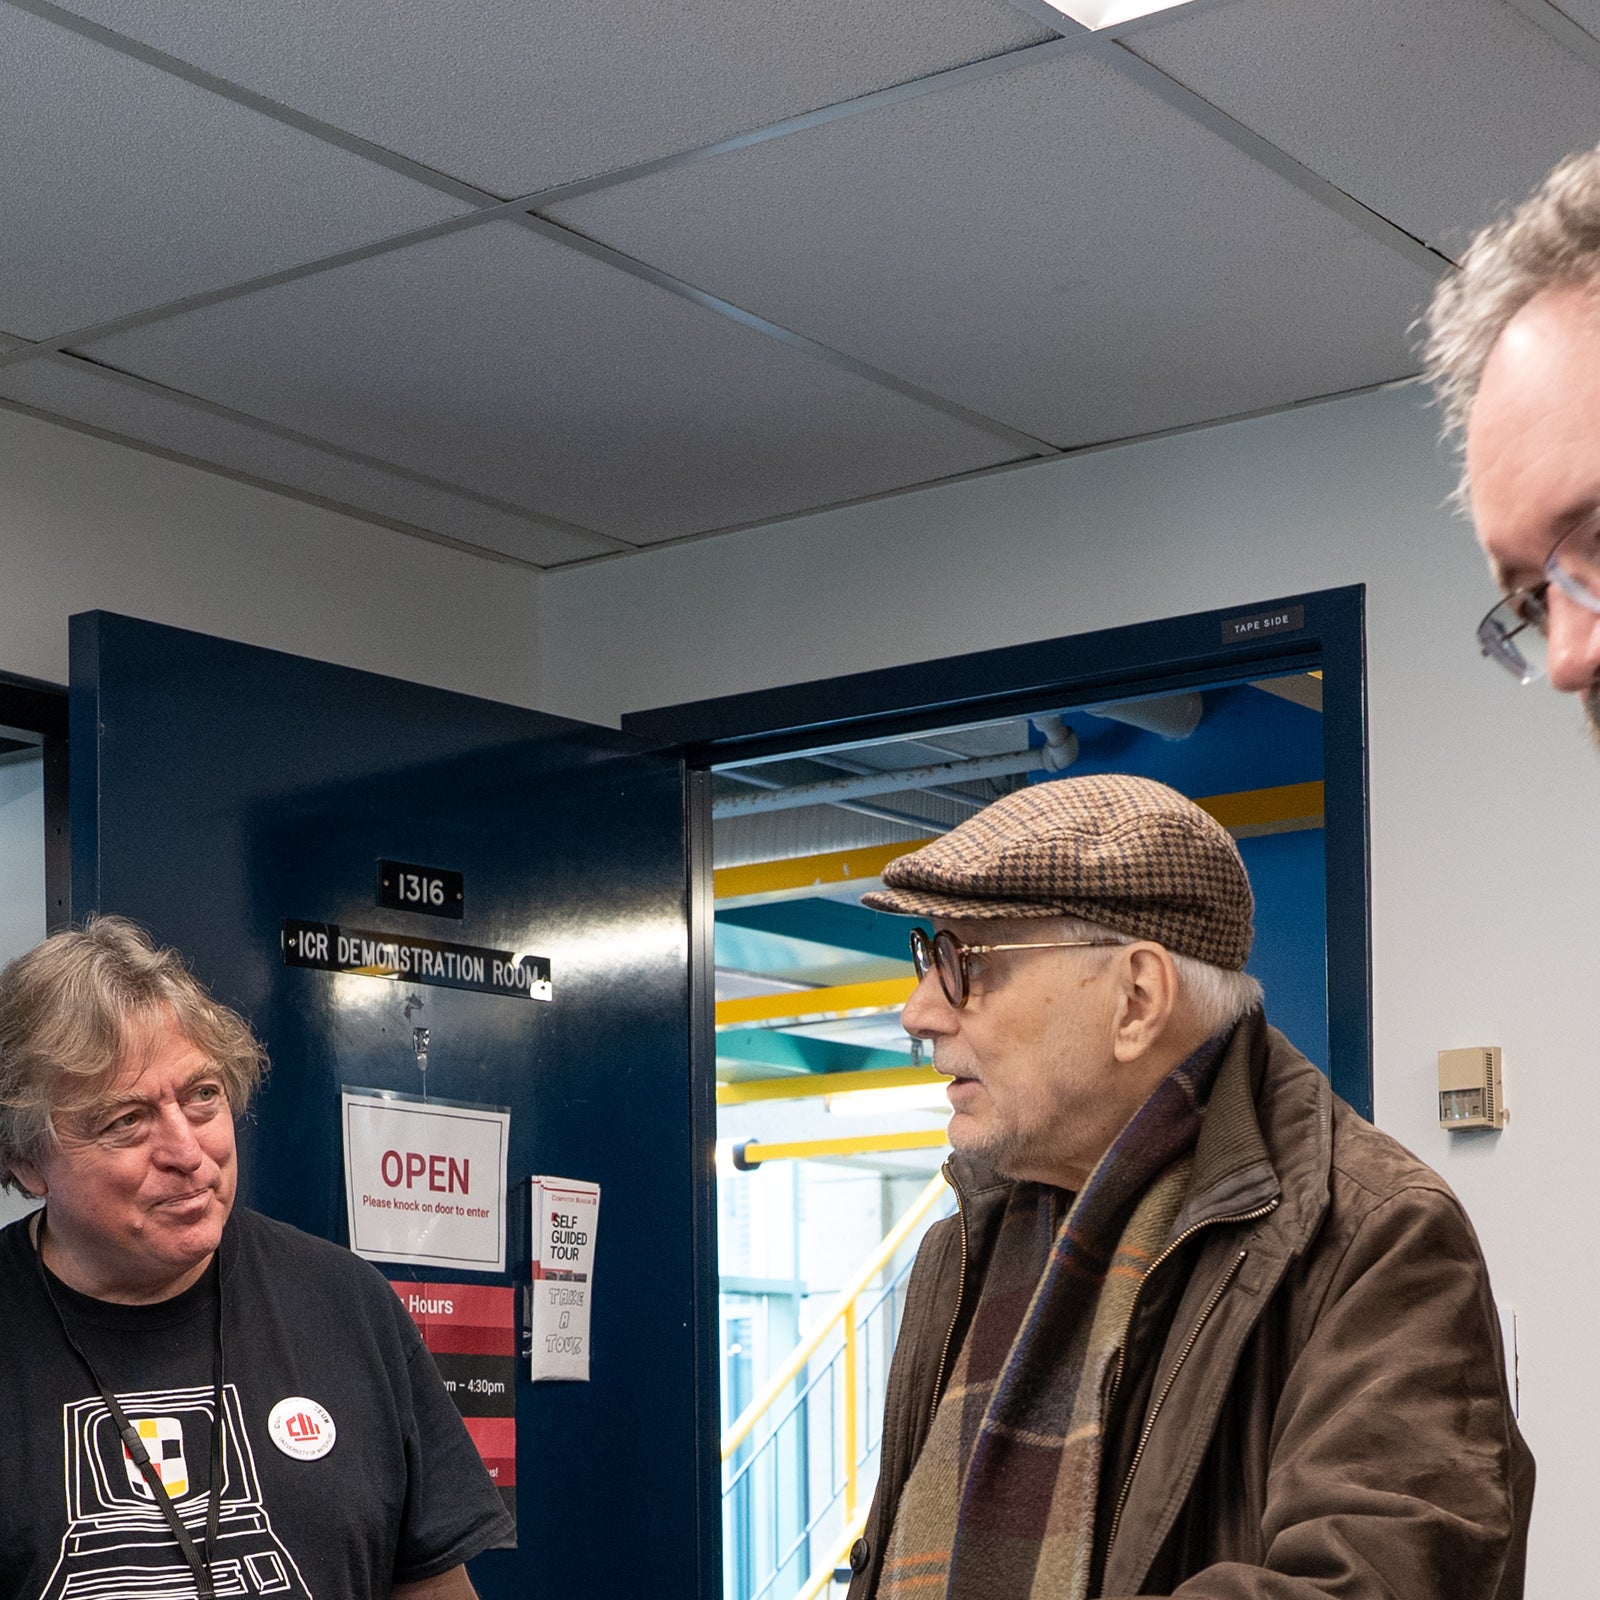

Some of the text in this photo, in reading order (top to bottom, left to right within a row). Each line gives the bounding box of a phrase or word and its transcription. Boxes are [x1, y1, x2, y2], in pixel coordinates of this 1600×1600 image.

[1234, 615, 1289, 634] TAPE SIDE
[399, 872, 444, 906] 1316
[298, 930, 538, 990] ICR DEMONSTRATION ROOM
[381, 1149, 469, 1195] OPEN
[362, 1194, 490, 1218] Please knock on door to enter
[552, 1214, 578, 1229] SELF
[551, 1230, 588, 1246] GUIDED
[550, 1245, 580, 1261] TOUR
[409, 1294, 454, 1314] Hours
[548, 1287, 584, 1307] TAKE
[559, 1311, 570, 1329] A
[467, 1378, 505, 1396] 4:30pm
